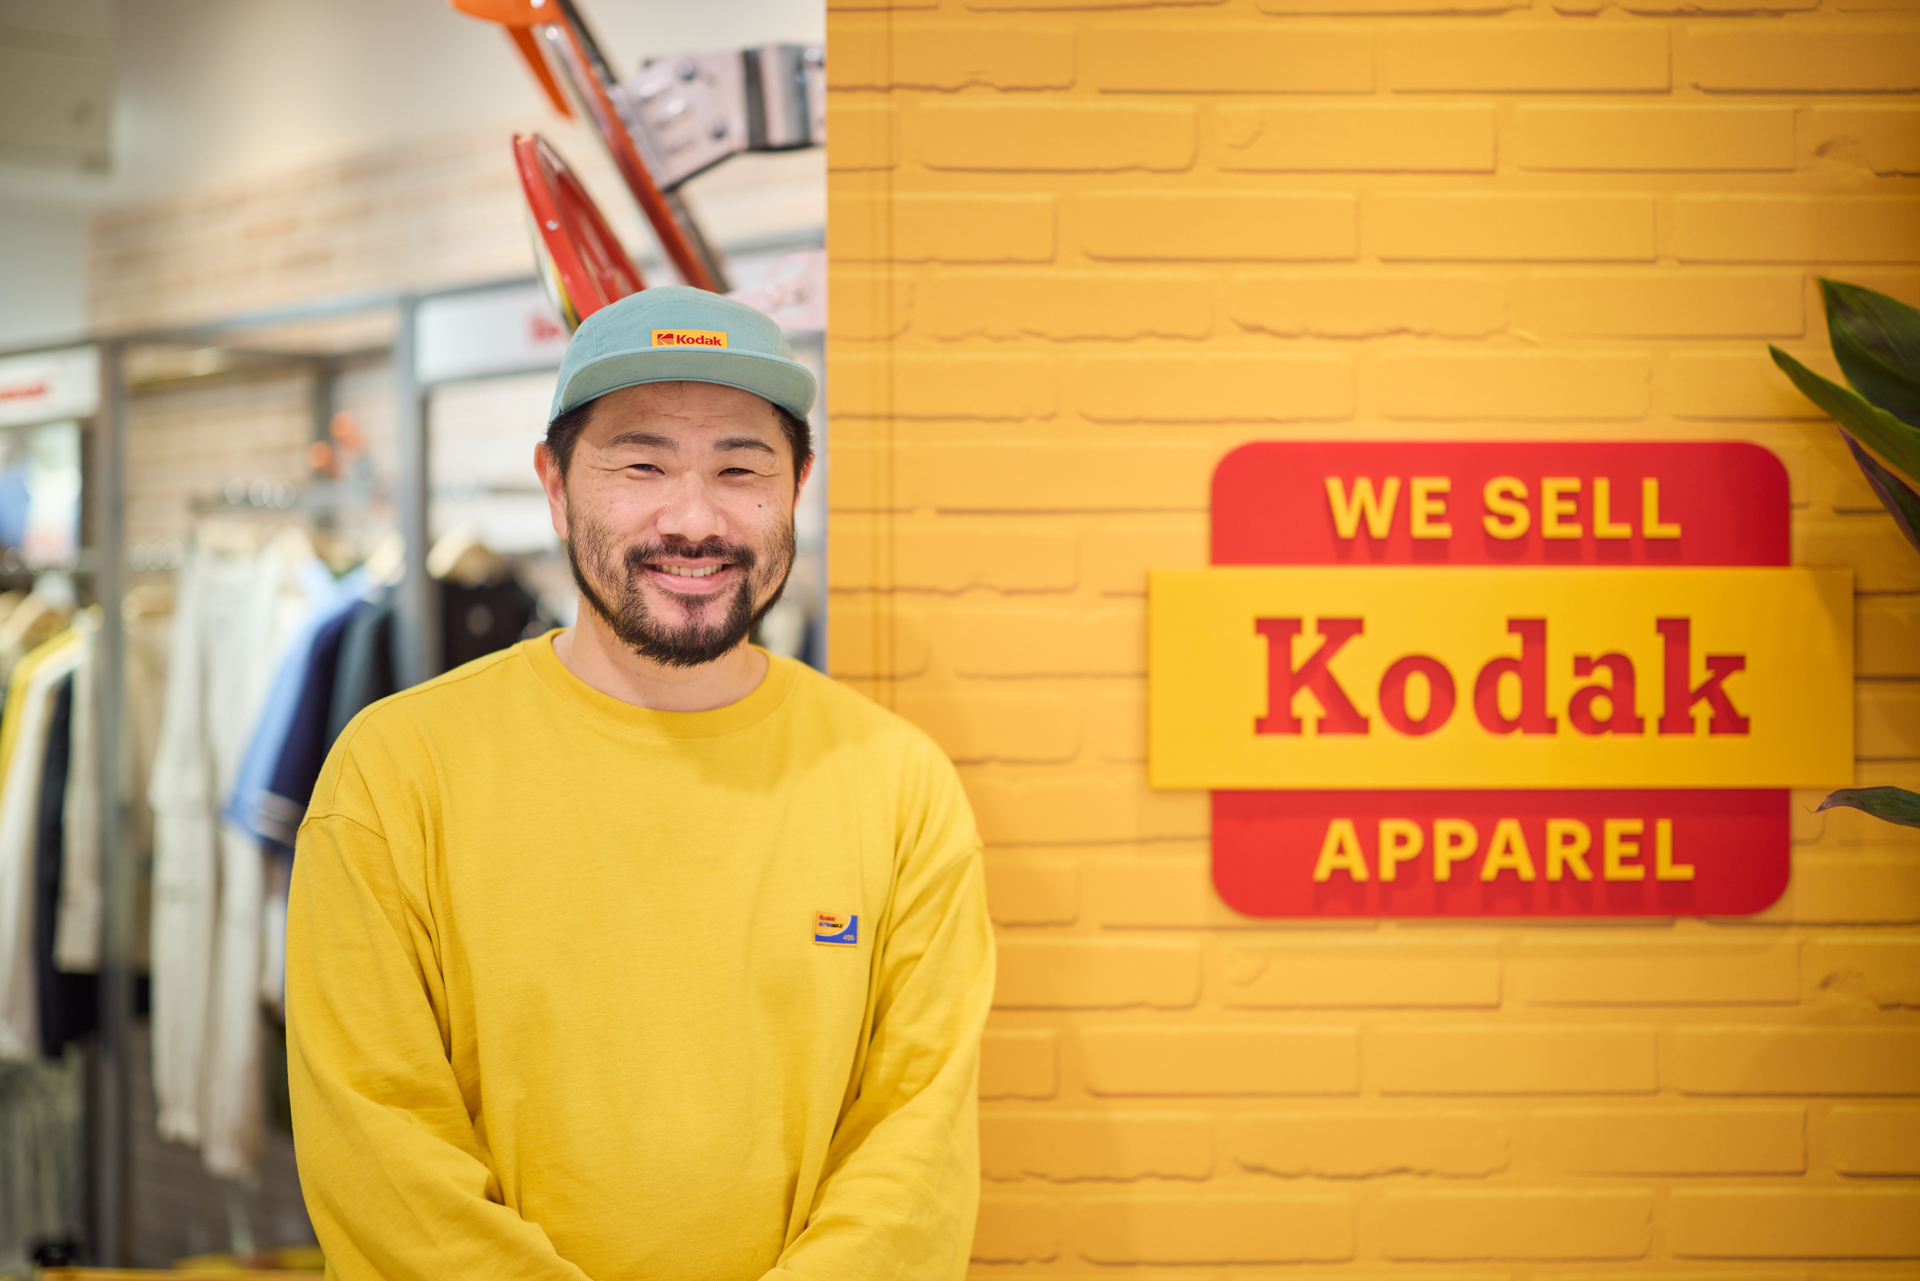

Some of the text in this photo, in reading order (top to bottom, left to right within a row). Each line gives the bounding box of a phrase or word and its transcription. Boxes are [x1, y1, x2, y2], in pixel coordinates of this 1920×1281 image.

[676, 334, 722, 346] Kodak
[1326, 476, 1682, 540] WE SELL
[1254, 615, 1751, 738] Kodak
[1312, 818, 1696, 882] APPAREL
